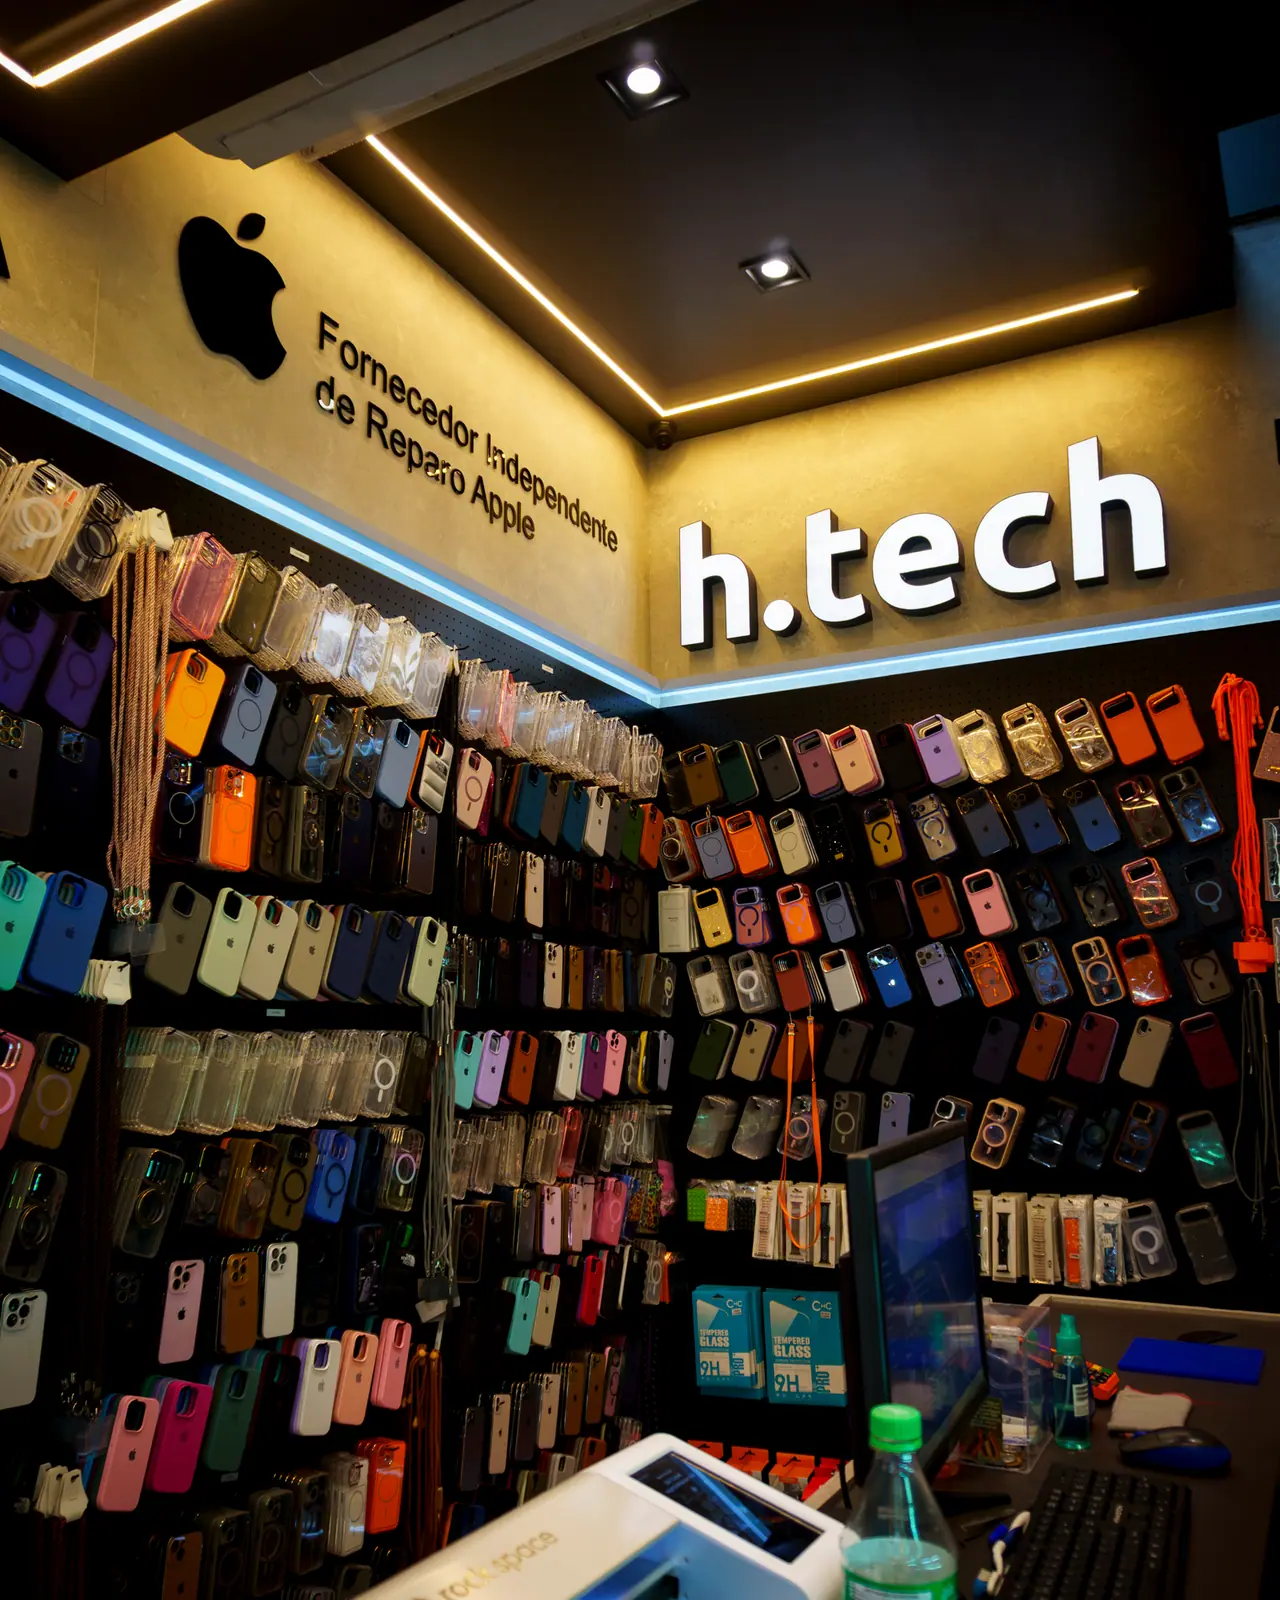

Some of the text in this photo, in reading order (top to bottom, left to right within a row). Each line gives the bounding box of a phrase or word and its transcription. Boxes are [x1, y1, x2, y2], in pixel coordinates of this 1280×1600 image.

[318, 311, 619, 553] Fornecedor Independente
[315, 375, 537, 541] de Reparo Apple
[679, 435, 1169, 652] h.tech
[699, 1328, 729, 1337] TEMPERED
[773, 1336, 811, 1345] TEMPERED
[699, 1337, 730, 1348] GLASS
[773, 1345, 812, 1359] GLASS
[700, 1360, 721, 1376] 9H
[775, 1374, 799, 1392] 9H
[437, 1531, 559, 1600] rock space
